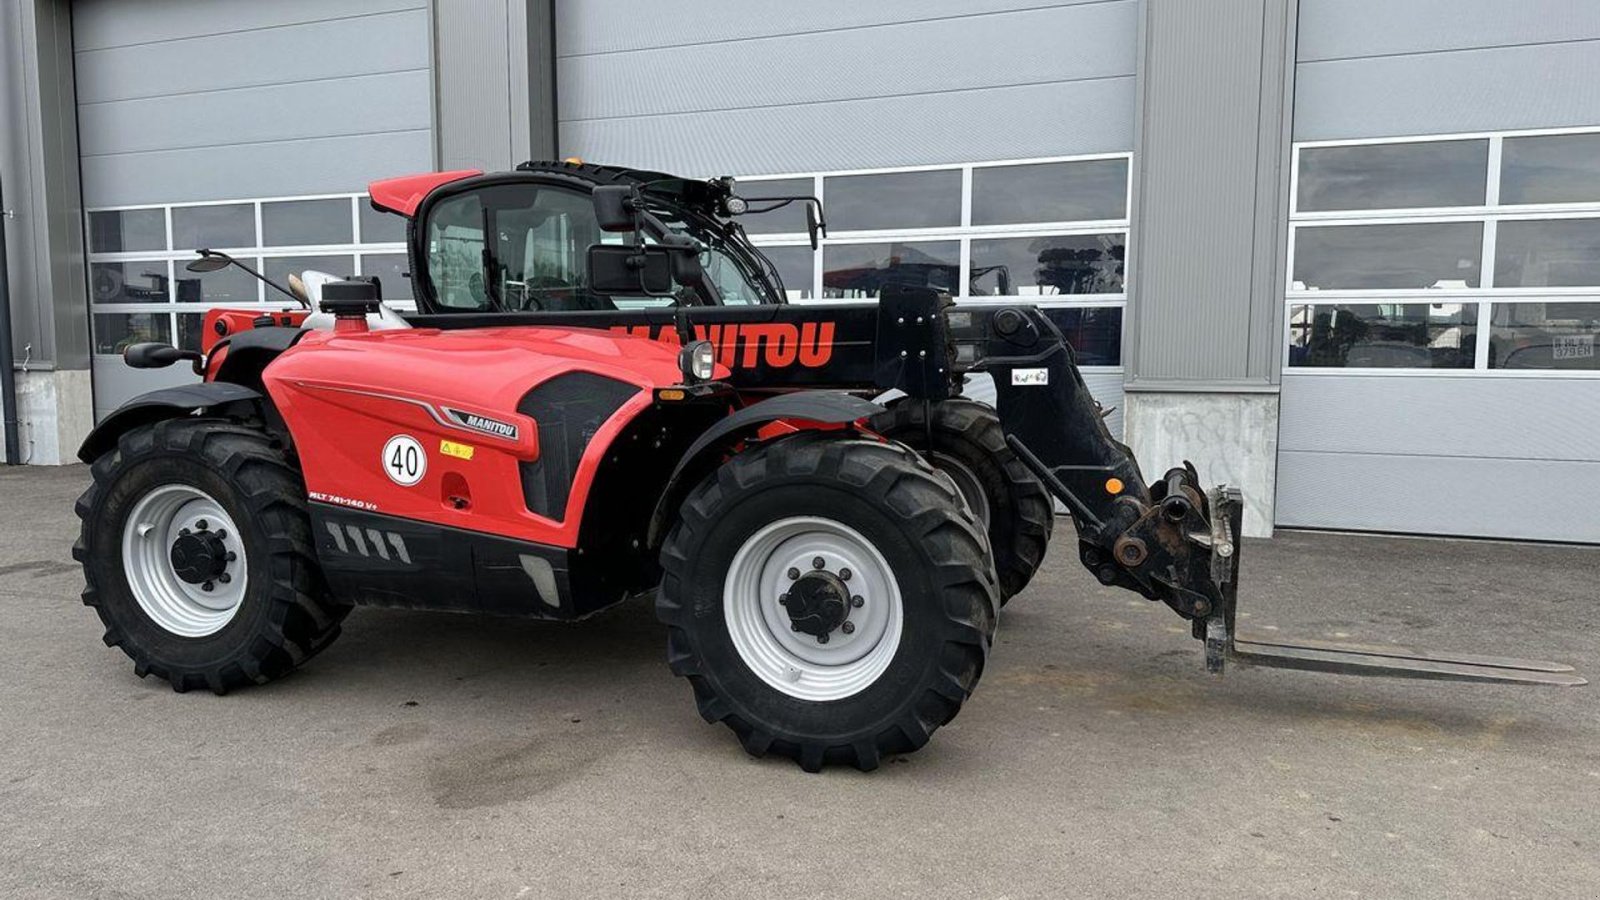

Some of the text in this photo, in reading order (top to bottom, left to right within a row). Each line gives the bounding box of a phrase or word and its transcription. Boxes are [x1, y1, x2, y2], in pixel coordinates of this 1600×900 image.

[467, 415, 514, 435] MANITOU
[391, 444, 418, 477] 40
[309, 491, 327, 500] MLT
